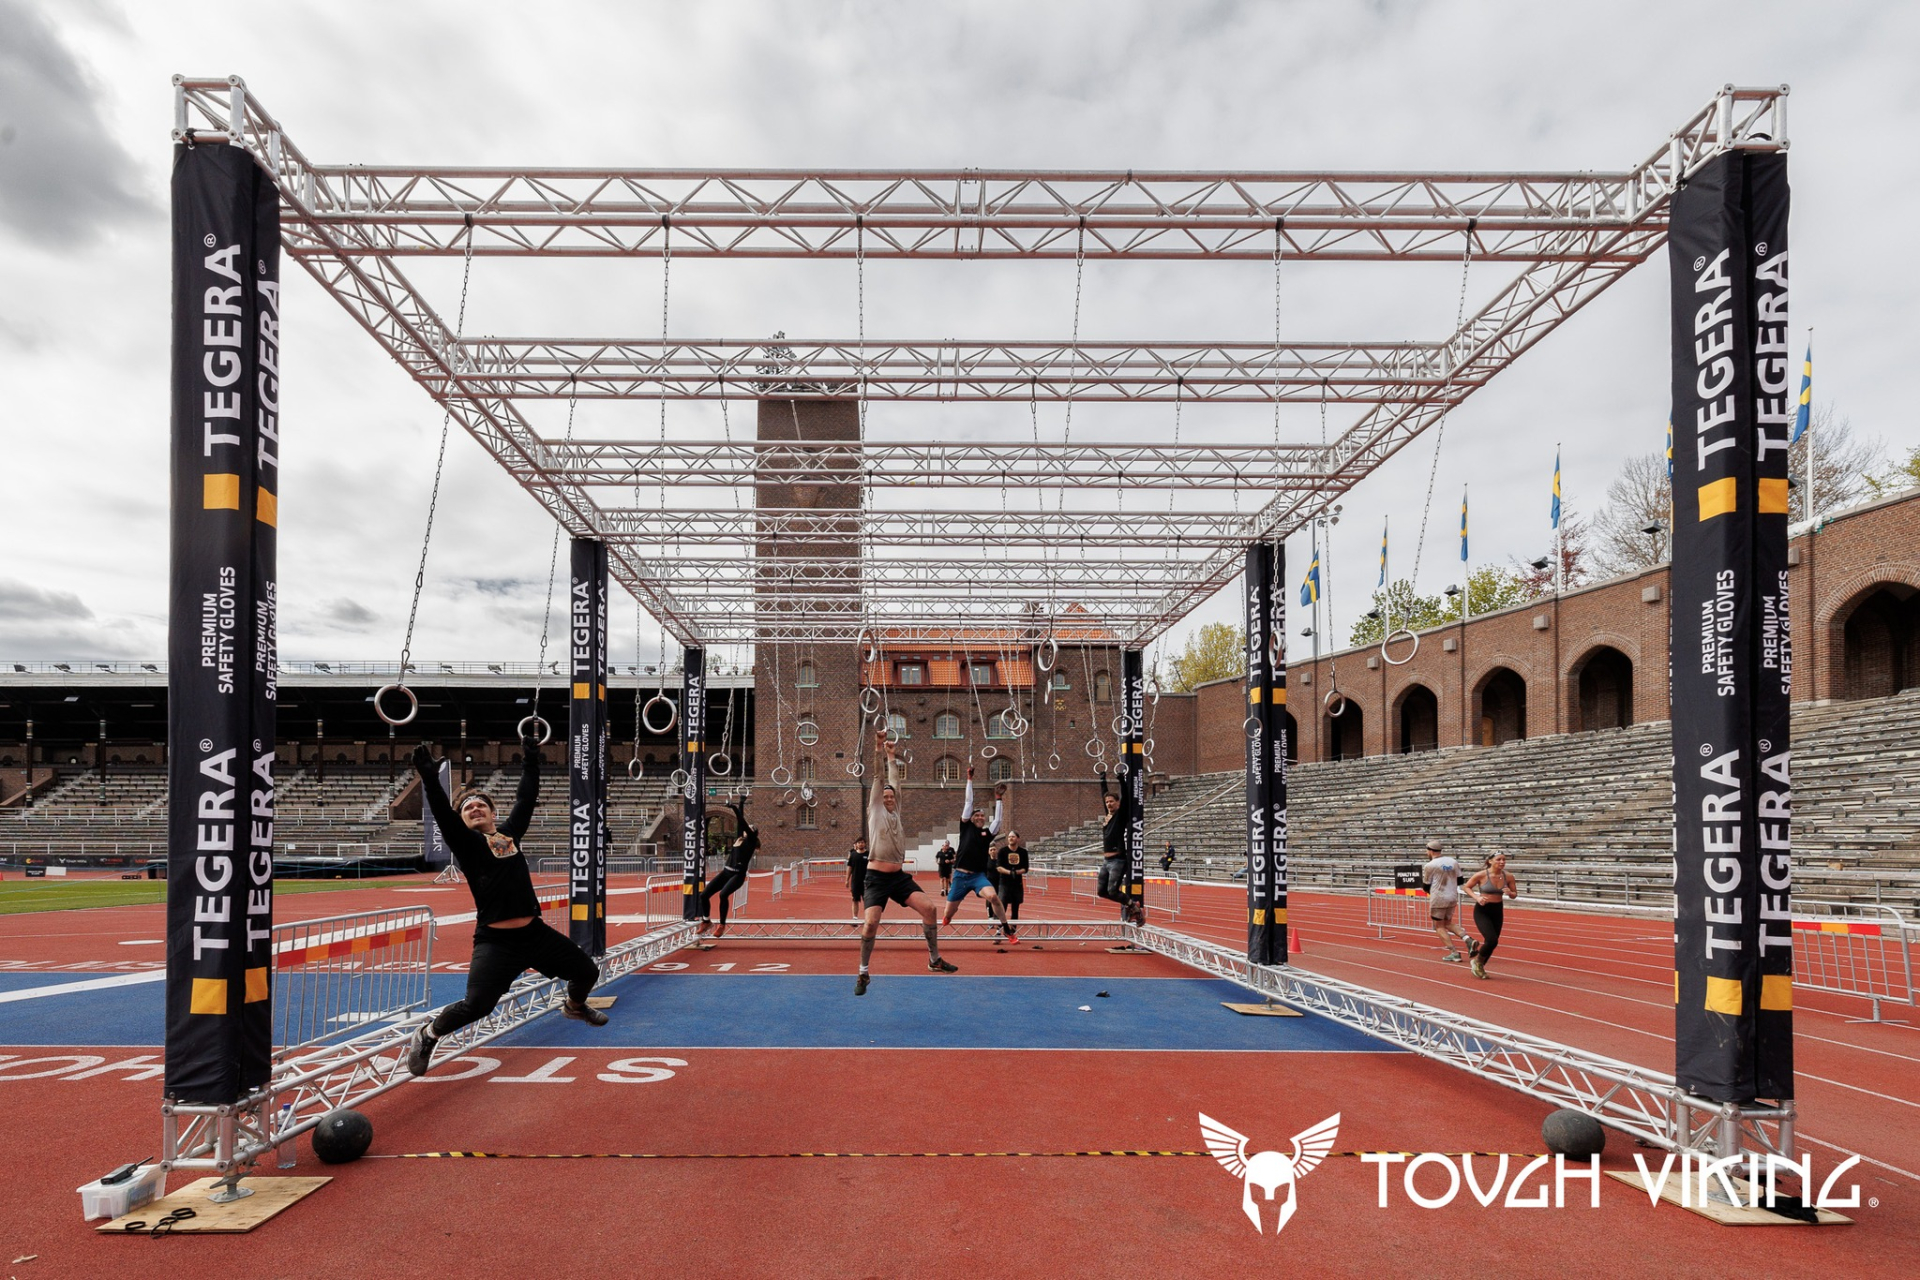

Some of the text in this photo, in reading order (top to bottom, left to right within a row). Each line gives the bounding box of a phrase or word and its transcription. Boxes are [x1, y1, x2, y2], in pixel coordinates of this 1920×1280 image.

[202, 594, 217, 667] PREMIUM
[218, 567, 235, 694] SAFETY GLOVES
[256, 600, 268, 672] PREMIUM
[1702, 599, 1715, 674] PREMIUM
[1716, 569, 1735, 696] SAFETY GLOVES
[1763, 596, 1778, 668] PREMIUM
[1781, 635, 1791, 694] SAFETY
[266, 641, 277, 700] SAFETY
[581, 723, 589, 780] SAFETY GLOVES
